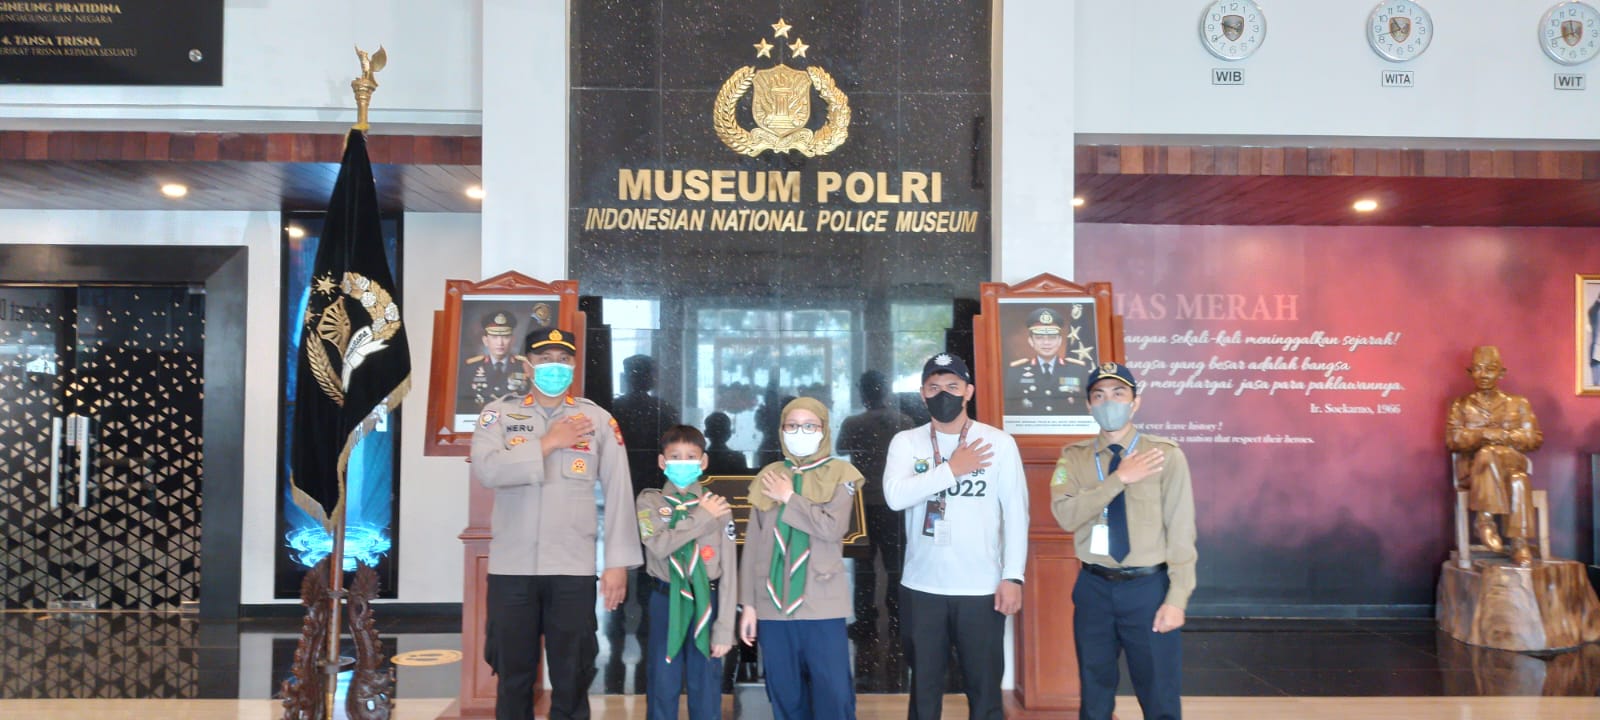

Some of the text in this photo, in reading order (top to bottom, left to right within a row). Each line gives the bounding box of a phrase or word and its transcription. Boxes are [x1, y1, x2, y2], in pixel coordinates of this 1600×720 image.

[55, 3, 122, 14] PRATIDINA
[14, 36, 53, 46] TANSA
[55, 36, 102, 47] TRISNA
[1215, 71, 1242, 82] WIB
[1385, 73, 1411, 84] WITA
[1558, 76, 1583, 87] WIT
[618, 168, 942, 204] MUSEUM POLRI
[584, 207, 979, 234] INDONESIAN NATIONAL POLICE MUSEUM
[1115, 293, 1299, 321] JAS MERAH
[1123, 330, 1401, 352] angan sekali-kali meninggalkan sejarah!
[1124, 355, 1351, 376] angsa yang besar adalah bangsa
[1150, 377, 1233, 396] menghargai
[1234, 379, 1270, 396] jasa
[1271, 379, 1305, 396] para
[1310, 403, 1323, 414] Ir.
[1376, 403, 1401, 414] 1966
[1214, 434, 1231, 443] that
[1231, 434, 1261, 445] respect
[1262, 434, 1282, 443] their
[934, 479, 987, 497] 022
